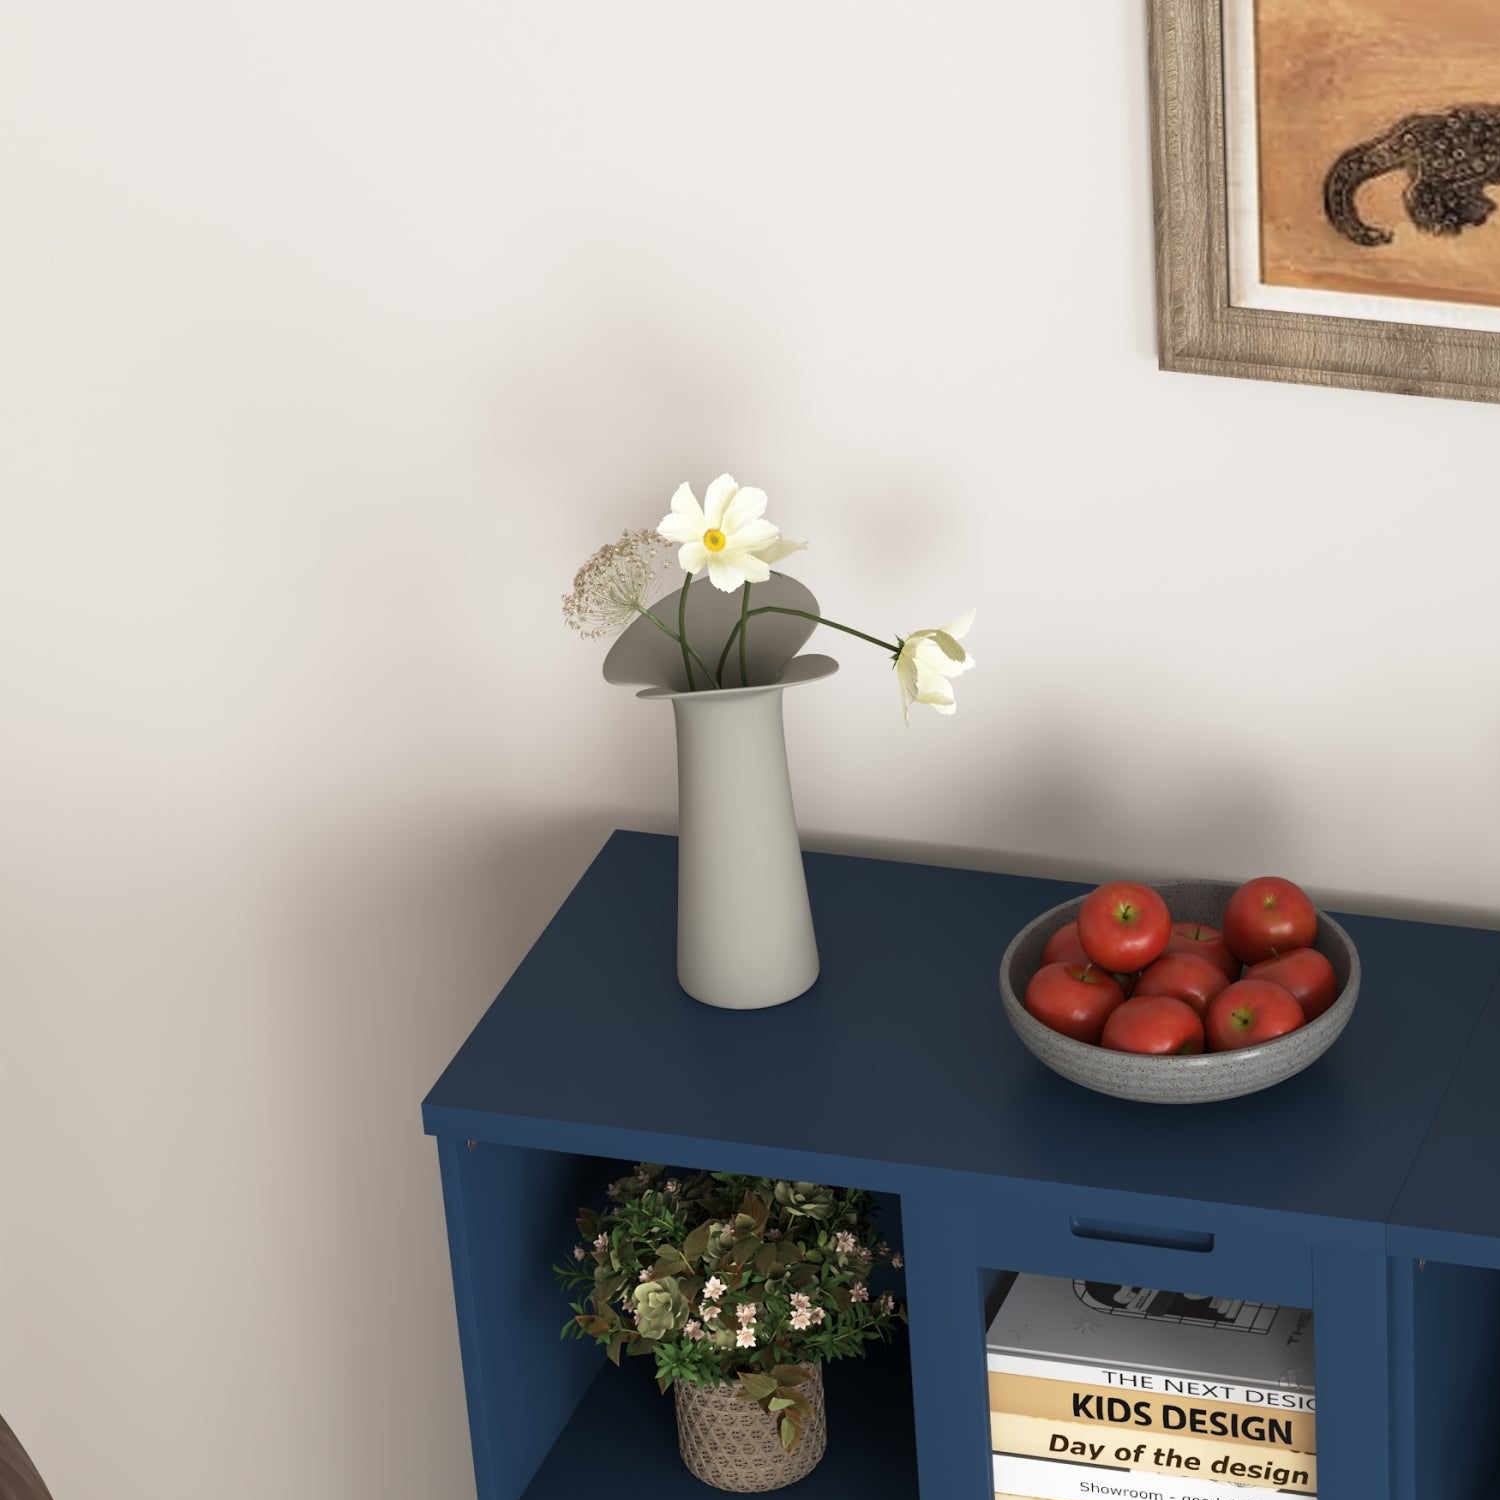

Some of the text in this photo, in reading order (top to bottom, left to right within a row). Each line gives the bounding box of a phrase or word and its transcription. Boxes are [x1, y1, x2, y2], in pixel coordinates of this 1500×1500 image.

[1102, 1370, 1316, 1411] THE NEXT DESI
[1072, 1392, 1293, 1445] KIDS DESIGN
[1049, 1433, 1309, 1486] Day of the design
